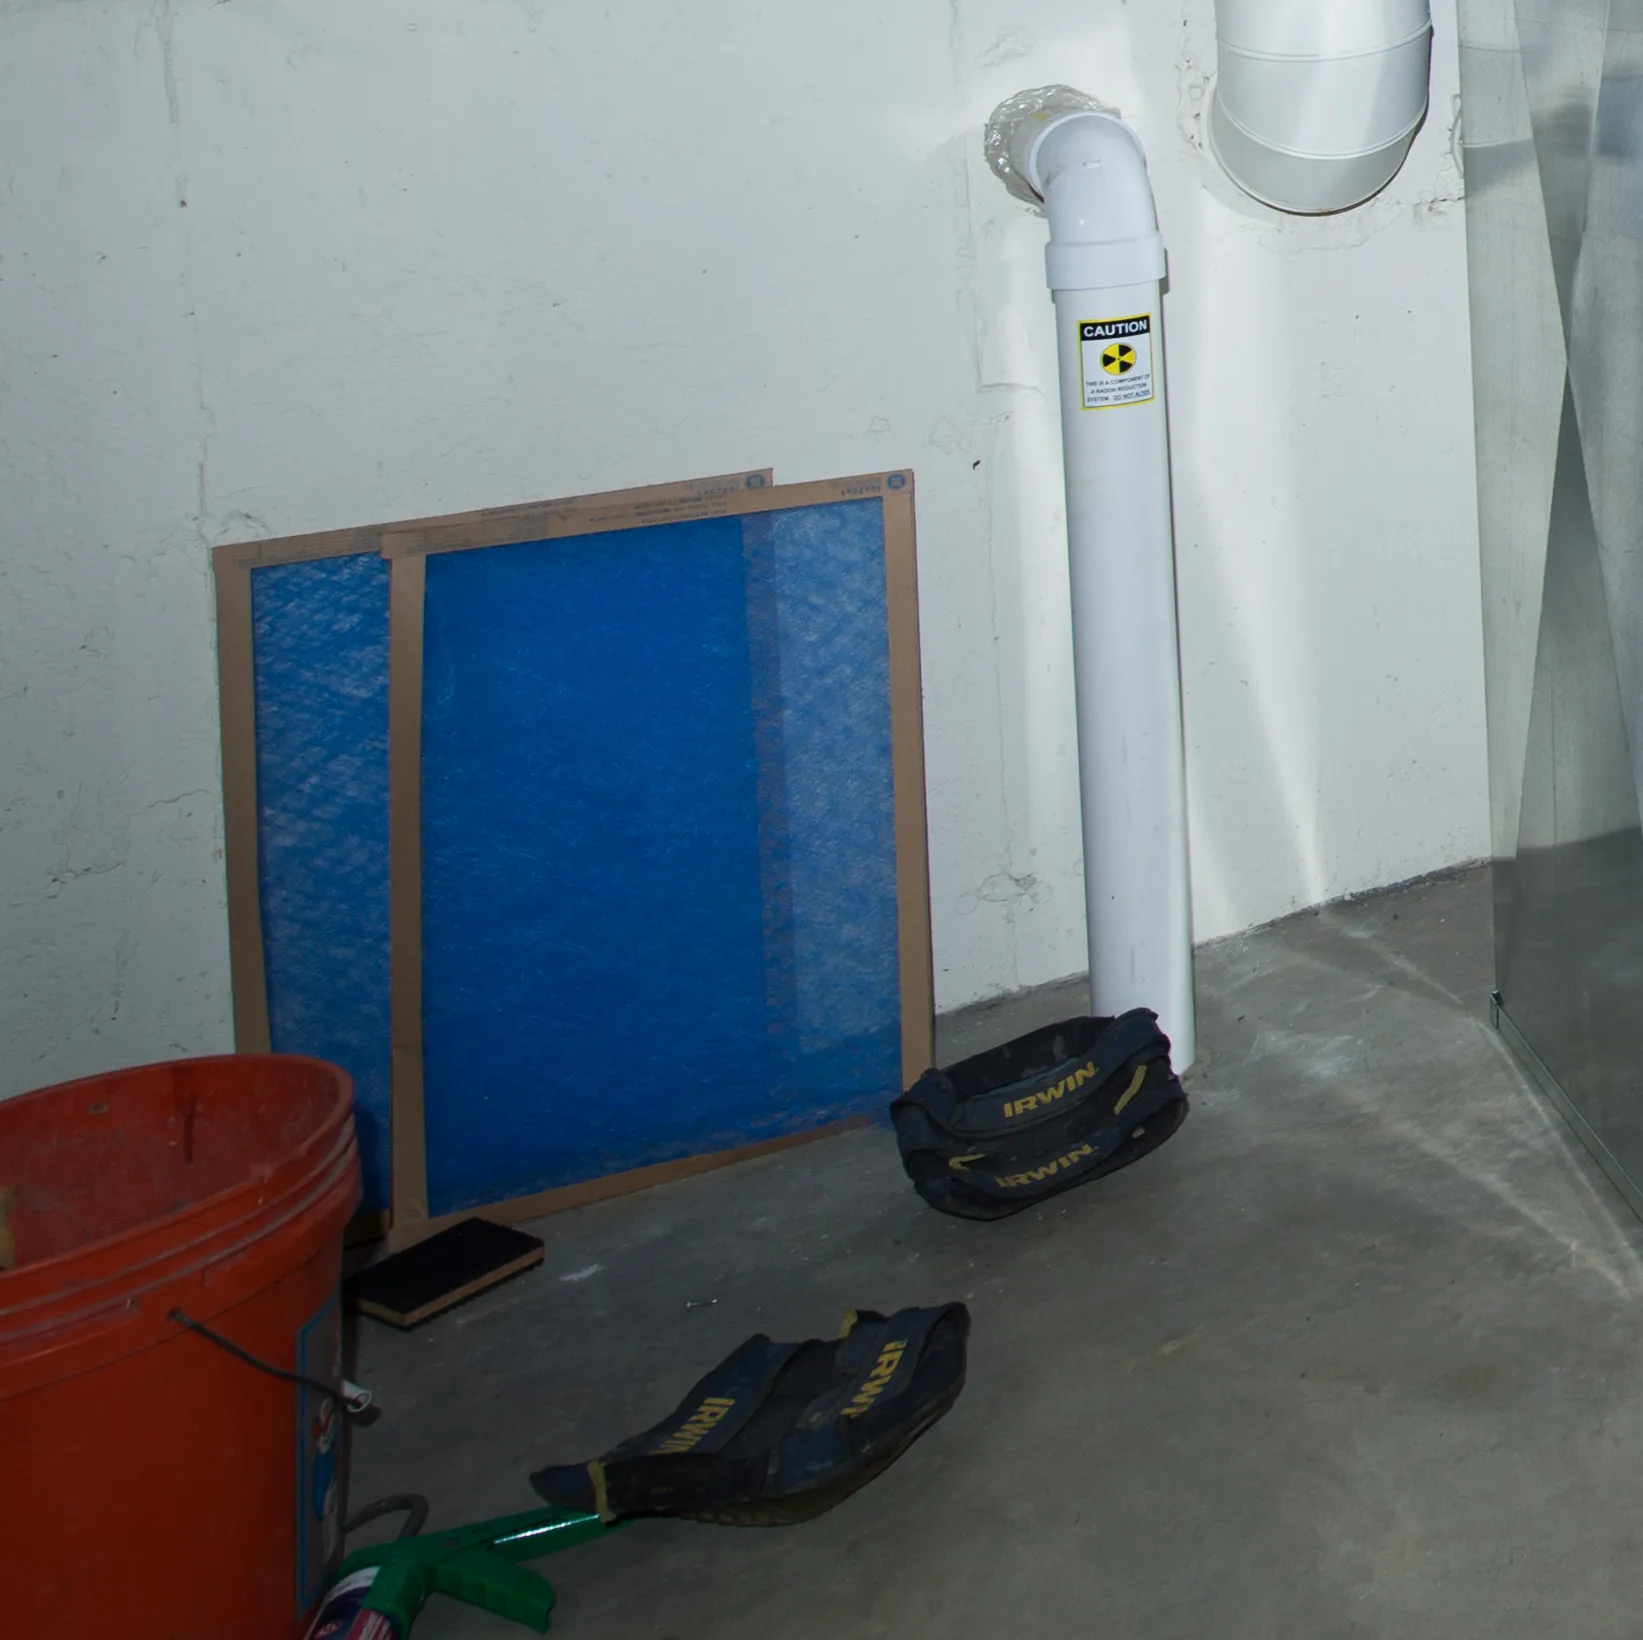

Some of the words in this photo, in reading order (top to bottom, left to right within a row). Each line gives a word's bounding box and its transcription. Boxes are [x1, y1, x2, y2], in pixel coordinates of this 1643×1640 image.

[1083, 320, 1147, 336] CAUTION
[1003, 1061, 1098, 1118] IRWIN
[995, 1142, 1096, 1188] IRWIN
